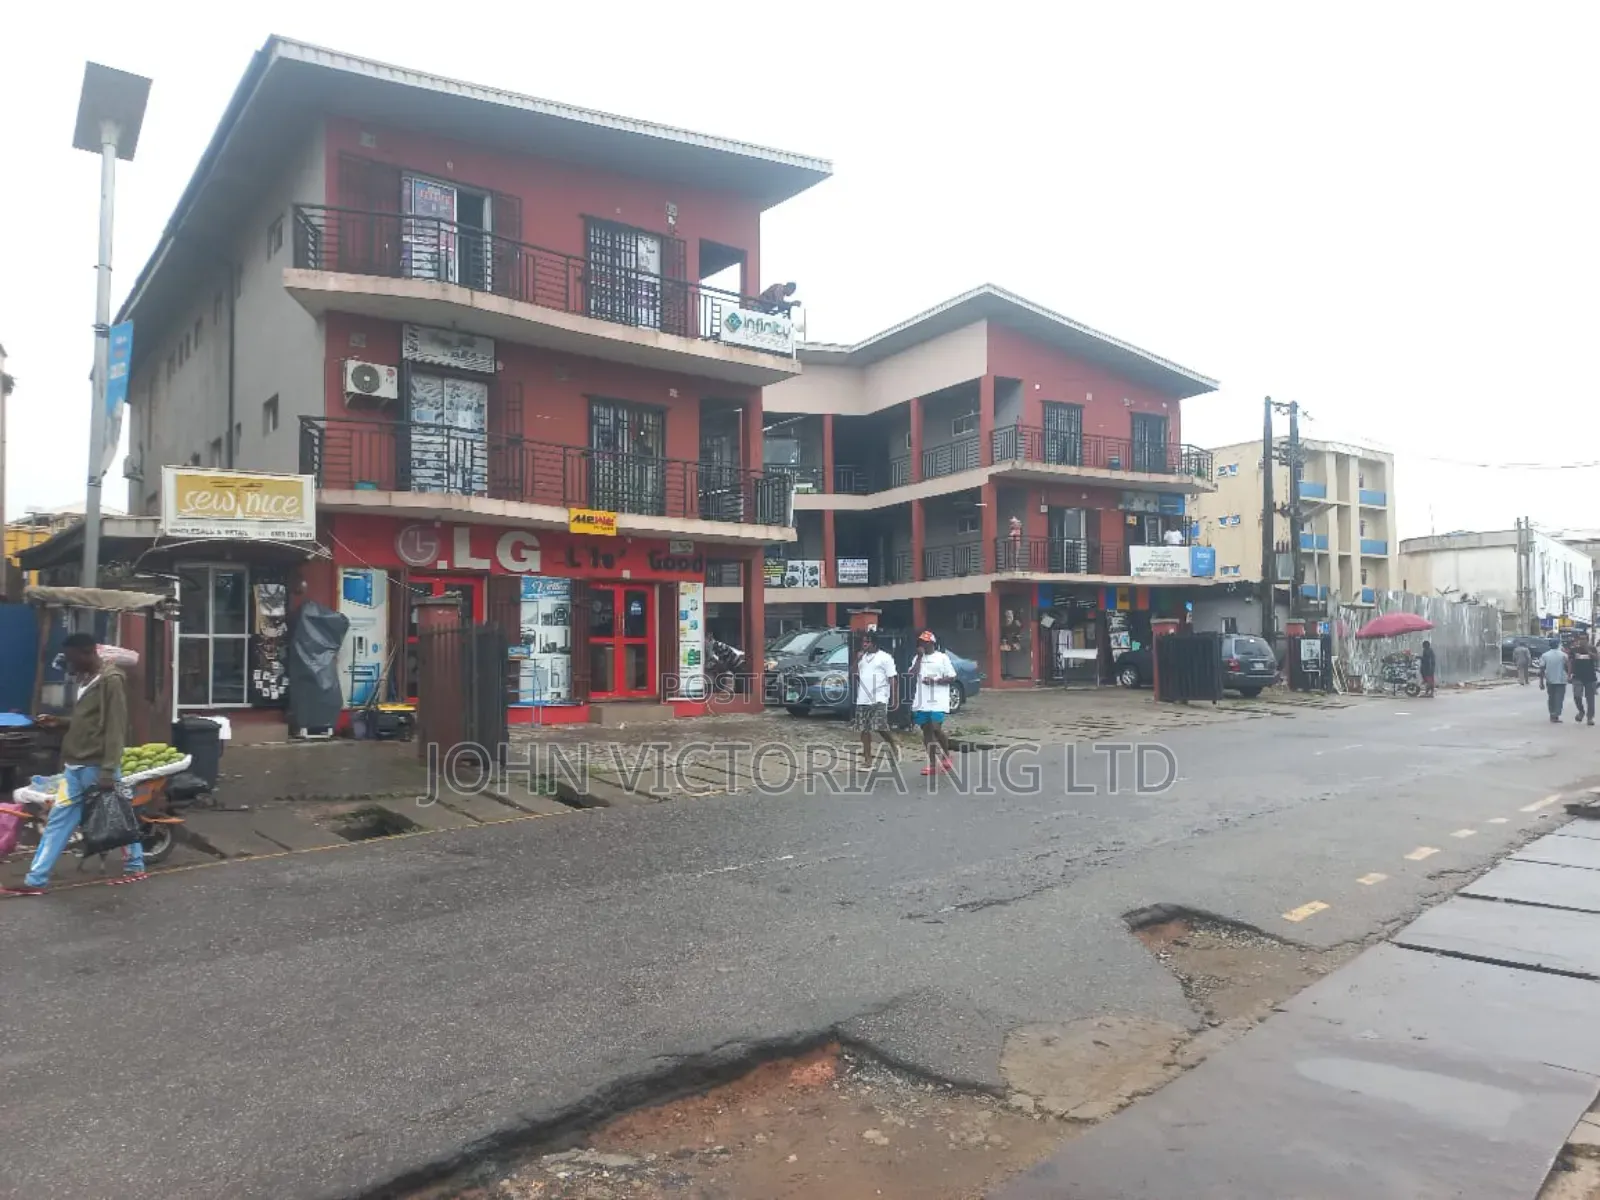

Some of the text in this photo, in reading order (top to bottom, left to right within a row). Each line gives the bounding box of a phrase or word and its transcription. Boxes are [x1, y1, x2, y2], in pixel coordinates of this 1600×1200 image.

[743, 313, 791, 339] infinity
[180, 489, 300, 514] sew nice
[453, 526, 541, 573] LG
